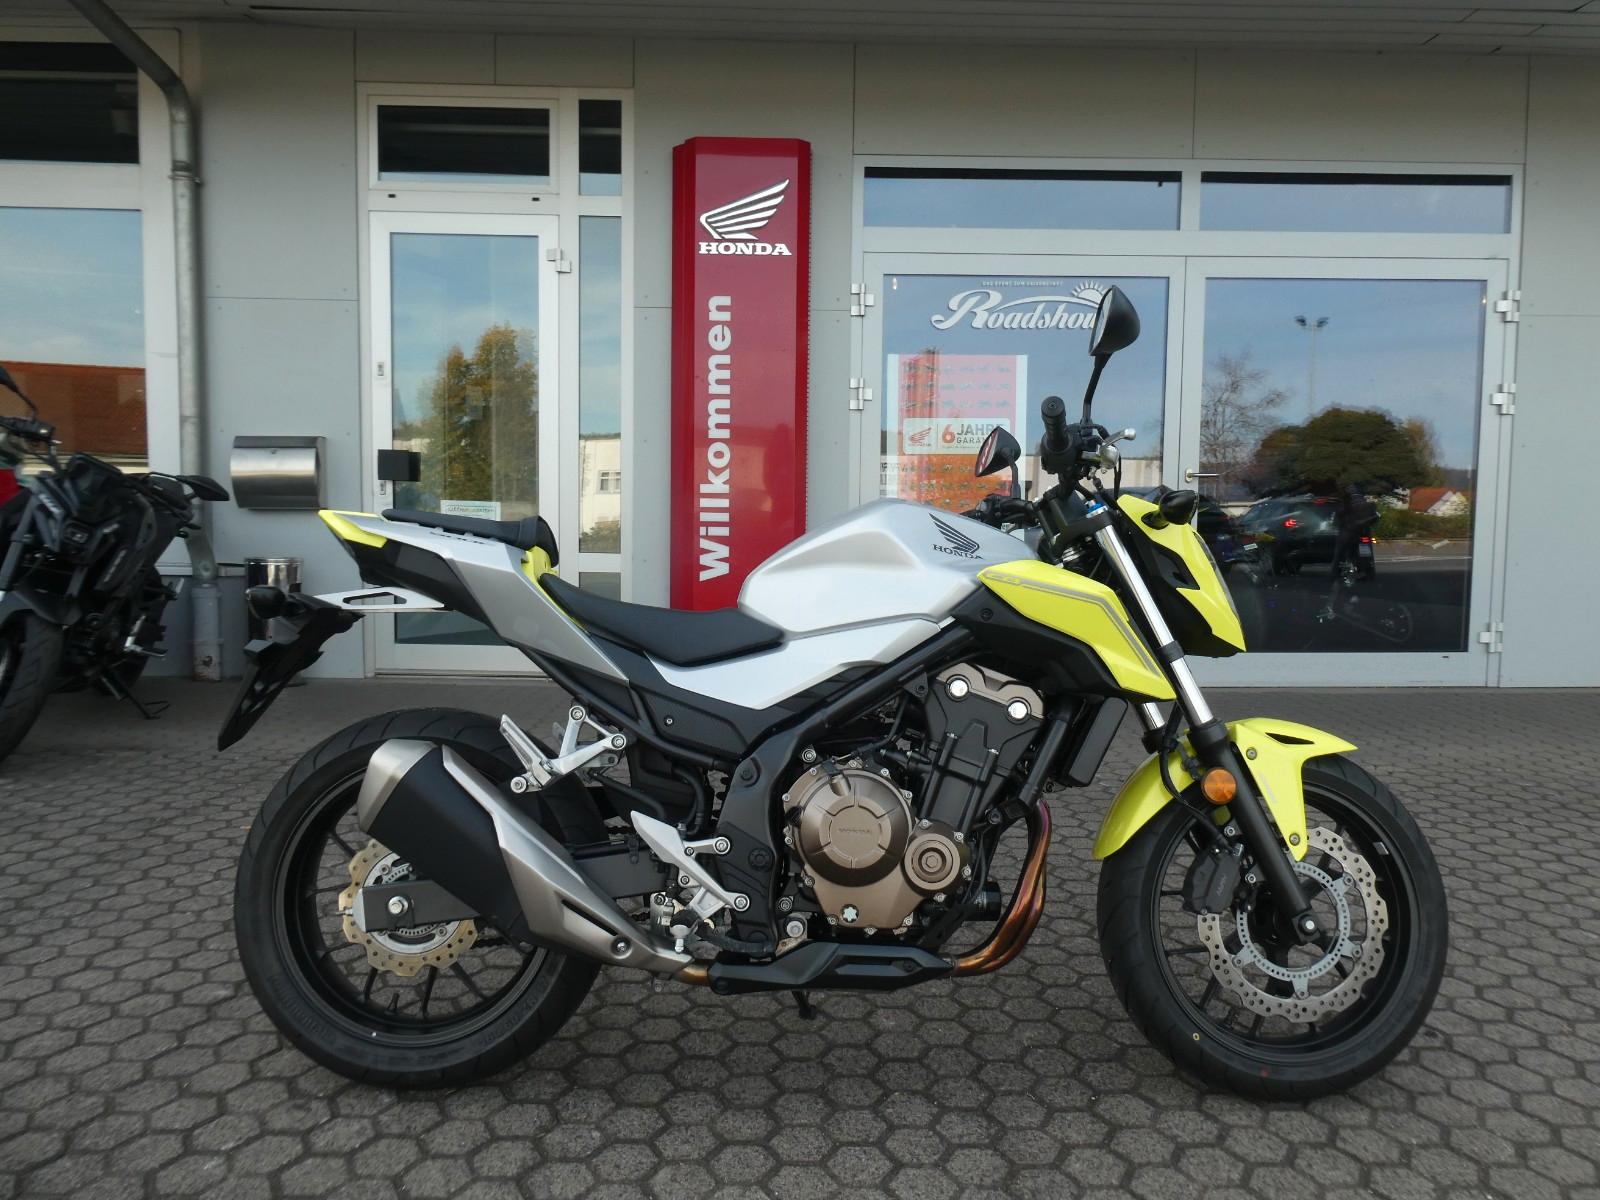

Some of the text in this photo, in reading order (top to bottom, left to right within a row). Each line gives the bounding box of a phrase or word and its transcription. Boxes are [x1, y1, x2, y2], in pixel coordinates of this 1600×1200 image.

[698, 241, 793, 256] HONDA
[699, 295, 732, 582] Willkommen
[942, 423, 1004, 444] 6 JAHR
[933, 544, 984, 560] HONDA
